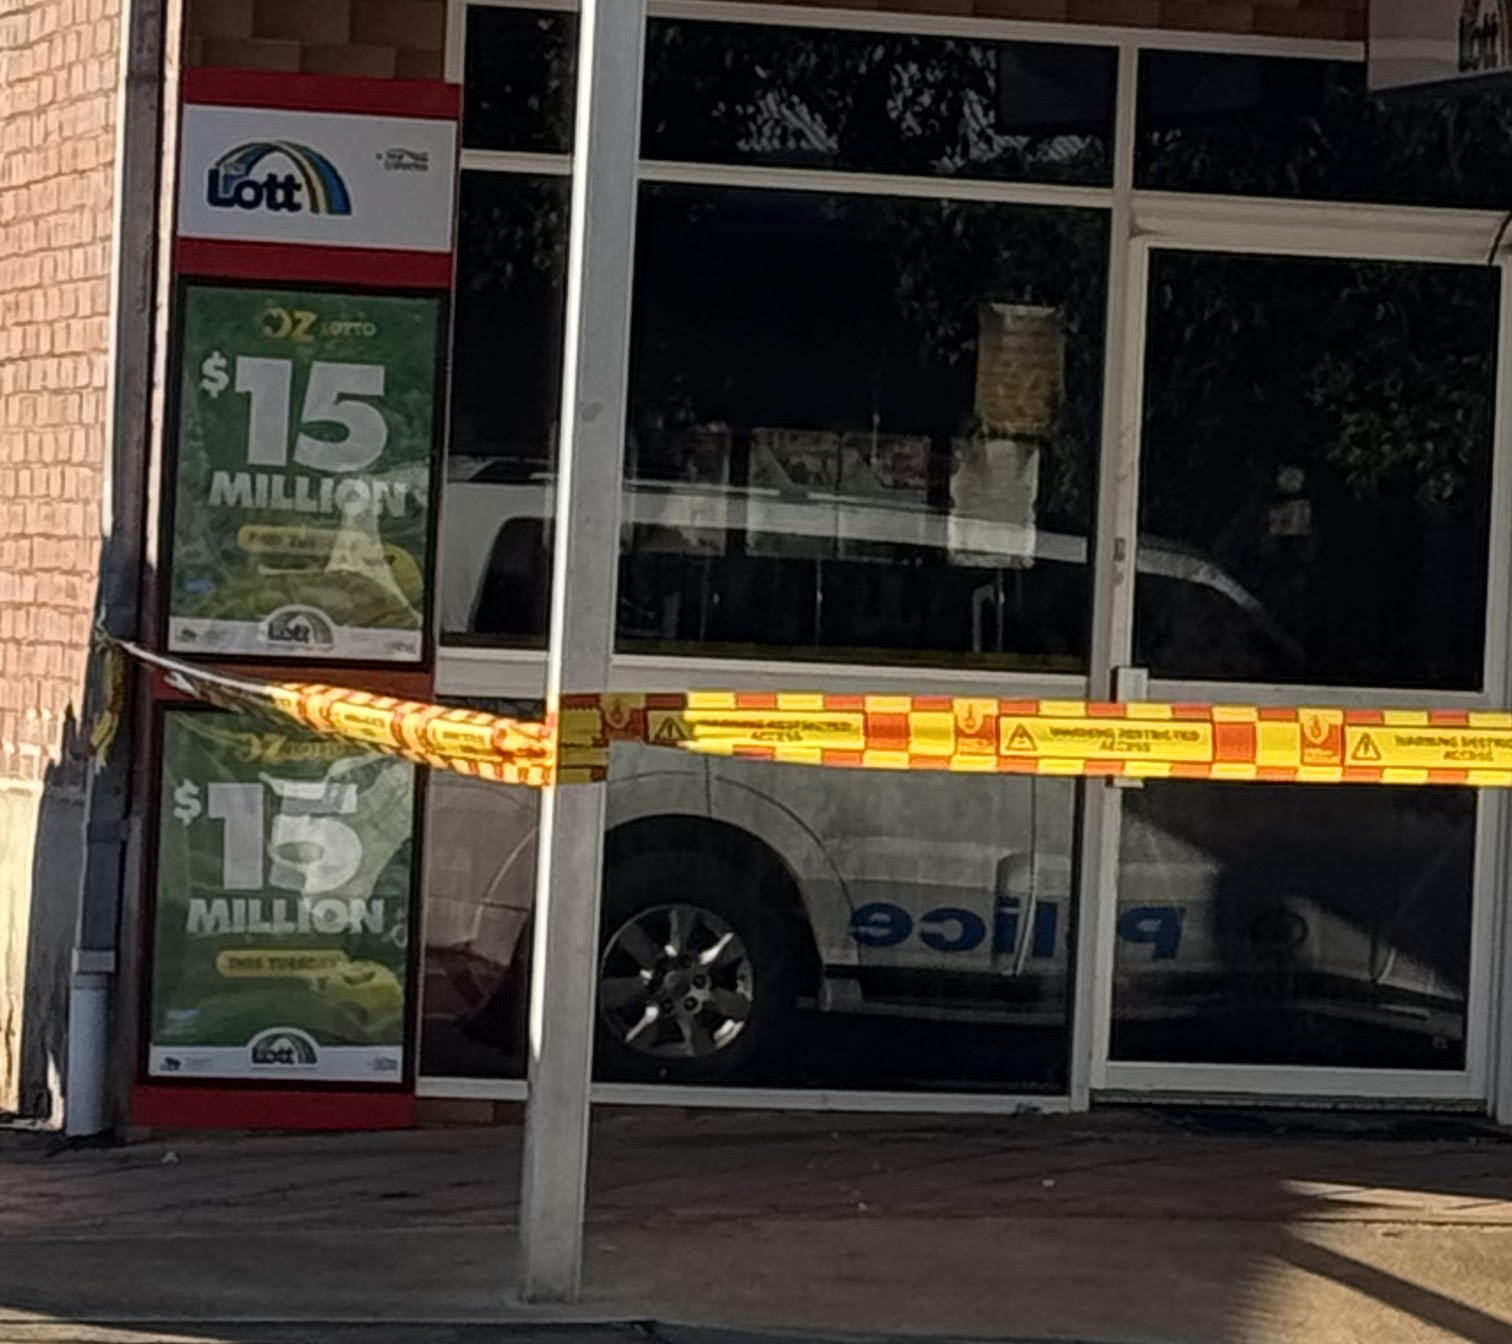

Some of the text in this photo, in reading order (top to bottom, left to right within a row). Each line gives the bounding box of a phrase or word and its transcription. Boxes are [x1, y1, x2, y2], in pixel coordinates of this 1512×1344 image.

[200, 351, 389, 474] $15
[208, 470, 406, 517] MILLION
[172, 777, 364, 895] $15
[185, 897, 385, 935] MILLION
